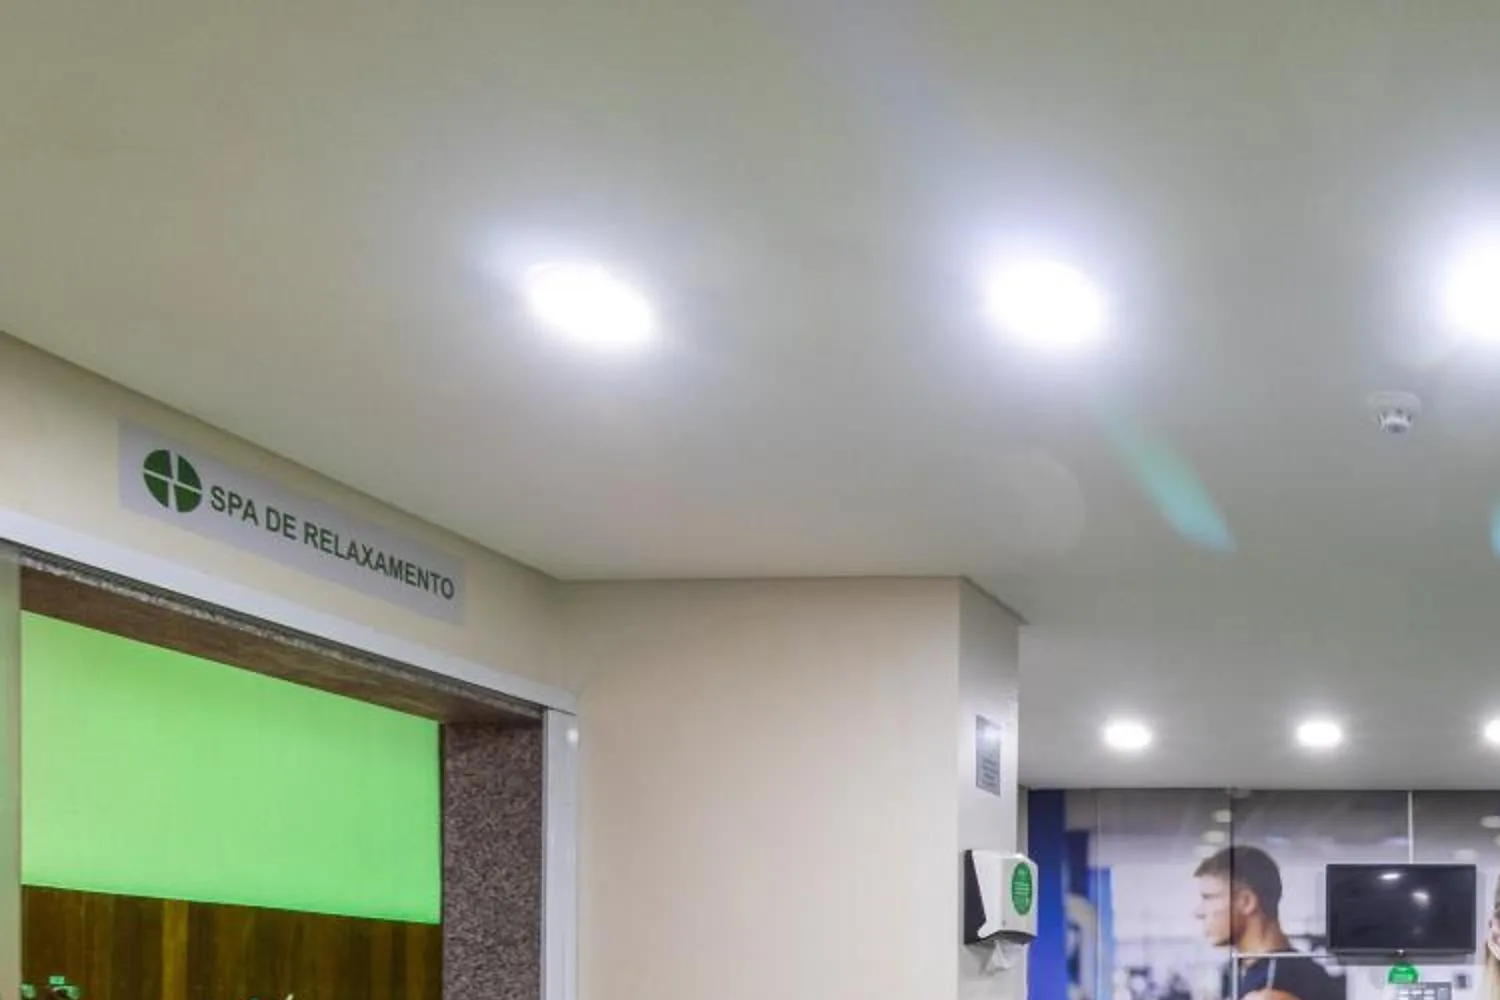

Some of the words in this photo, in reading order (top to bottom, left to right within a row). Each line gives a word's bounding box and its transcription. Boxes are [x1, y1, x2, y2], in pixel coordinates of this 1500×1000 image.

[210, 485, 259, 527] SPA
[265, 506, 298, 541] DE
[303, 520, 456, 600] RELAXAMENTO
